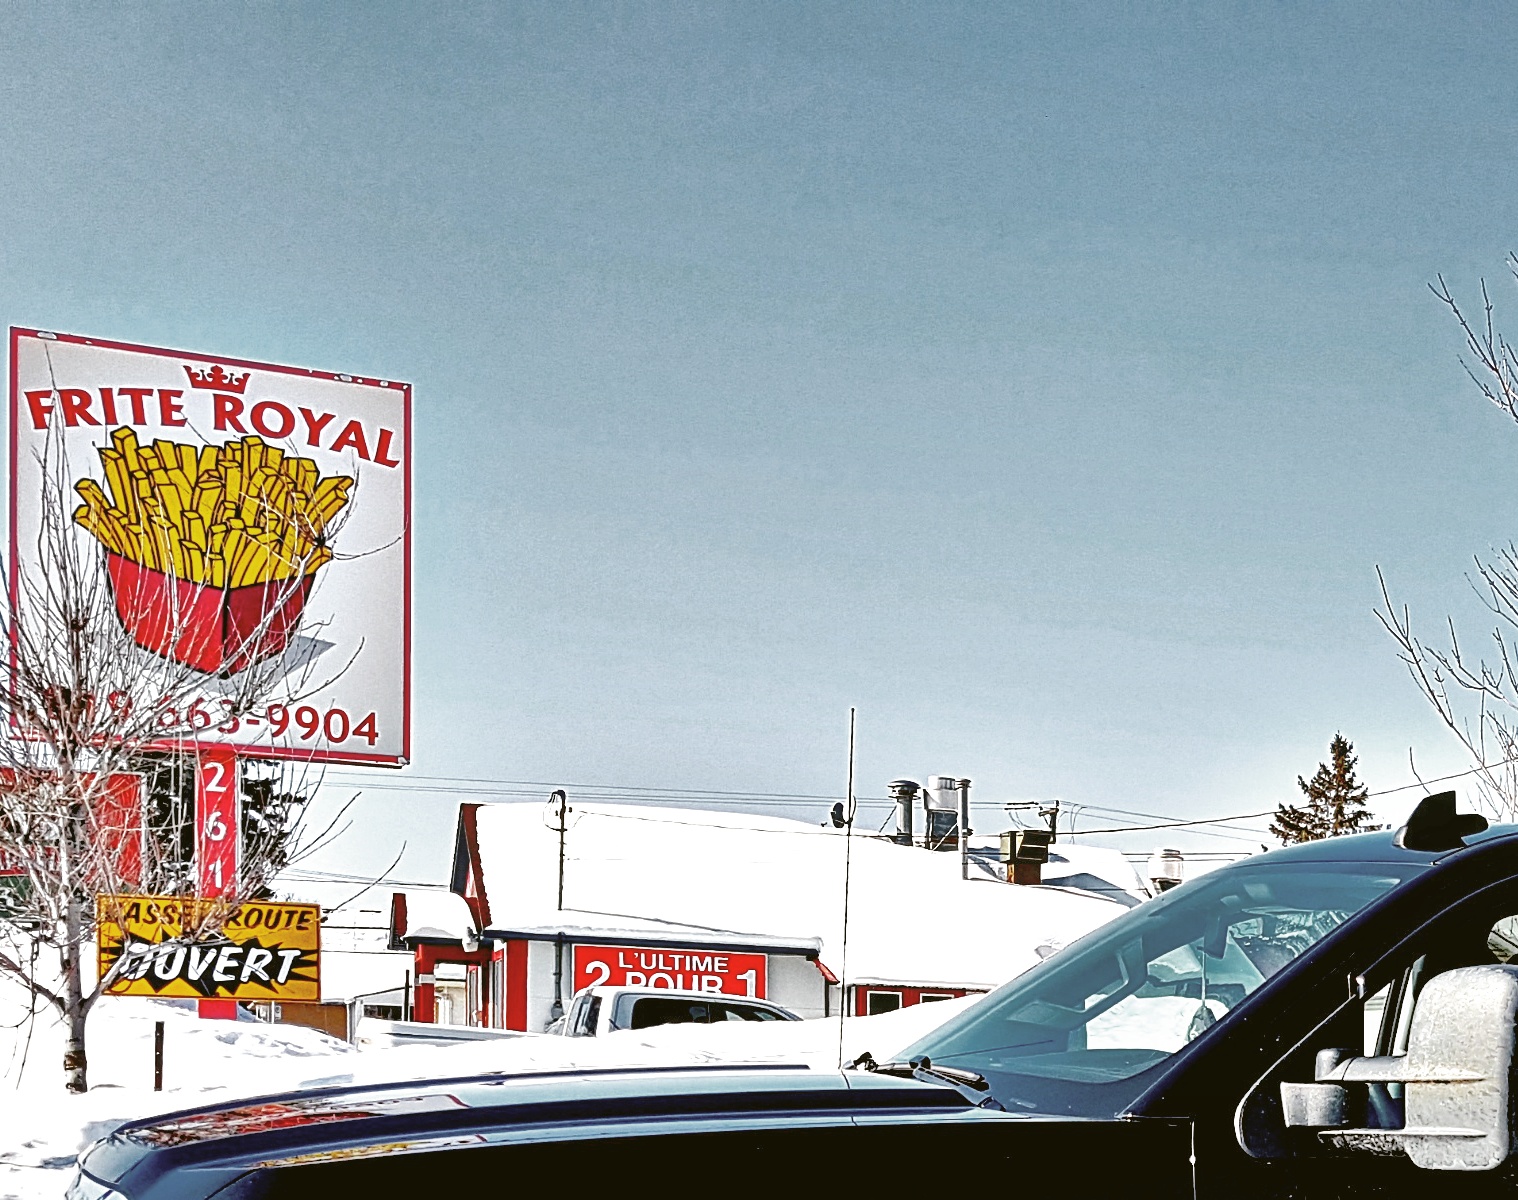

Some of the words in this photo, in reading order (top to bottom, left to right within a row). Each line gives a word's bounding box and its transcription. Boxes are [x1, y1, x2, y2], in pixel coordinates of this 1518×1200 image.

[24, 387, 188, 430] FRITE
[213, 393, 401, 468] ROYAL
[118, 942, 301, 983] OUVERT
[585, 960, 611, 989] 2
[736, 969, 757, 998] 1
[618, 951, 729, 973] L'ULTIME
